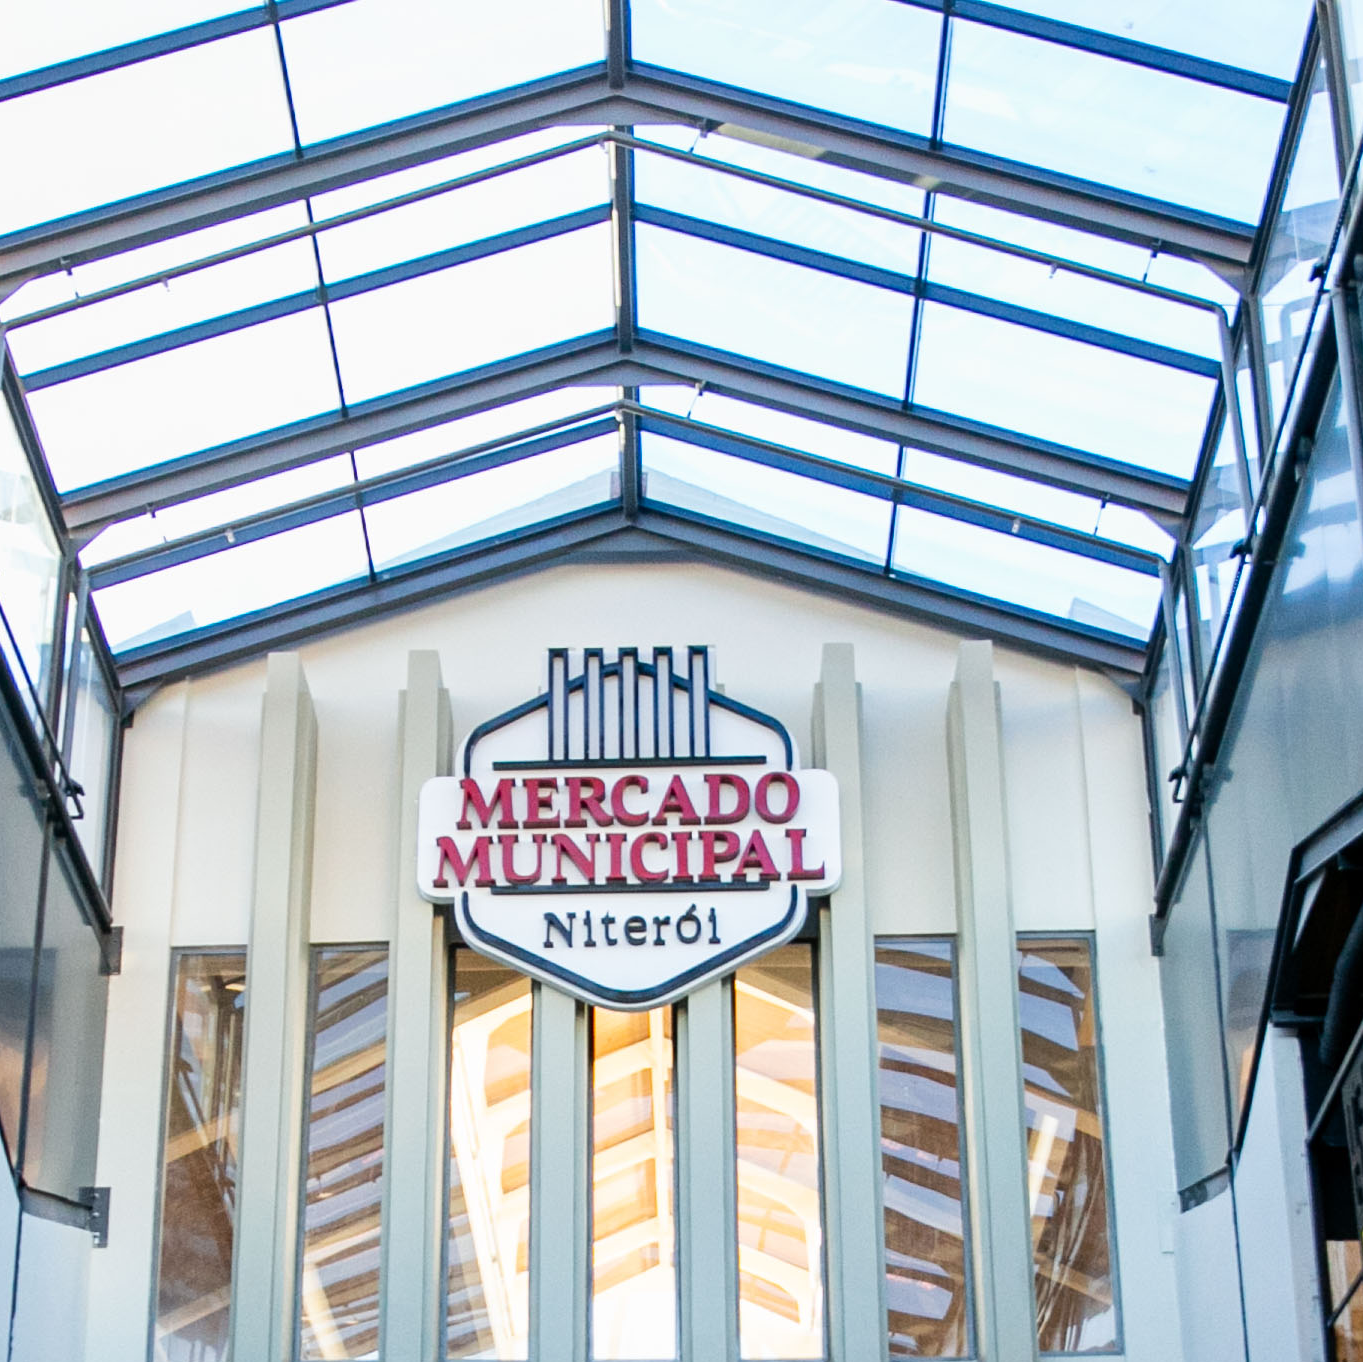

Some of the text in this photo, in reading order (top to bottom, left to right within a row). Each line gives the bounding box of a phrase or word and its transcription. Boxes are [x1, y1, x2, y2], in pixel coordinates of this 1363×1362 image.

[456, 771, 801, 830] MERCADO
[433, 828, 825, 888] MUNICIPAL
[543, 903, 722, 948] Niterói
